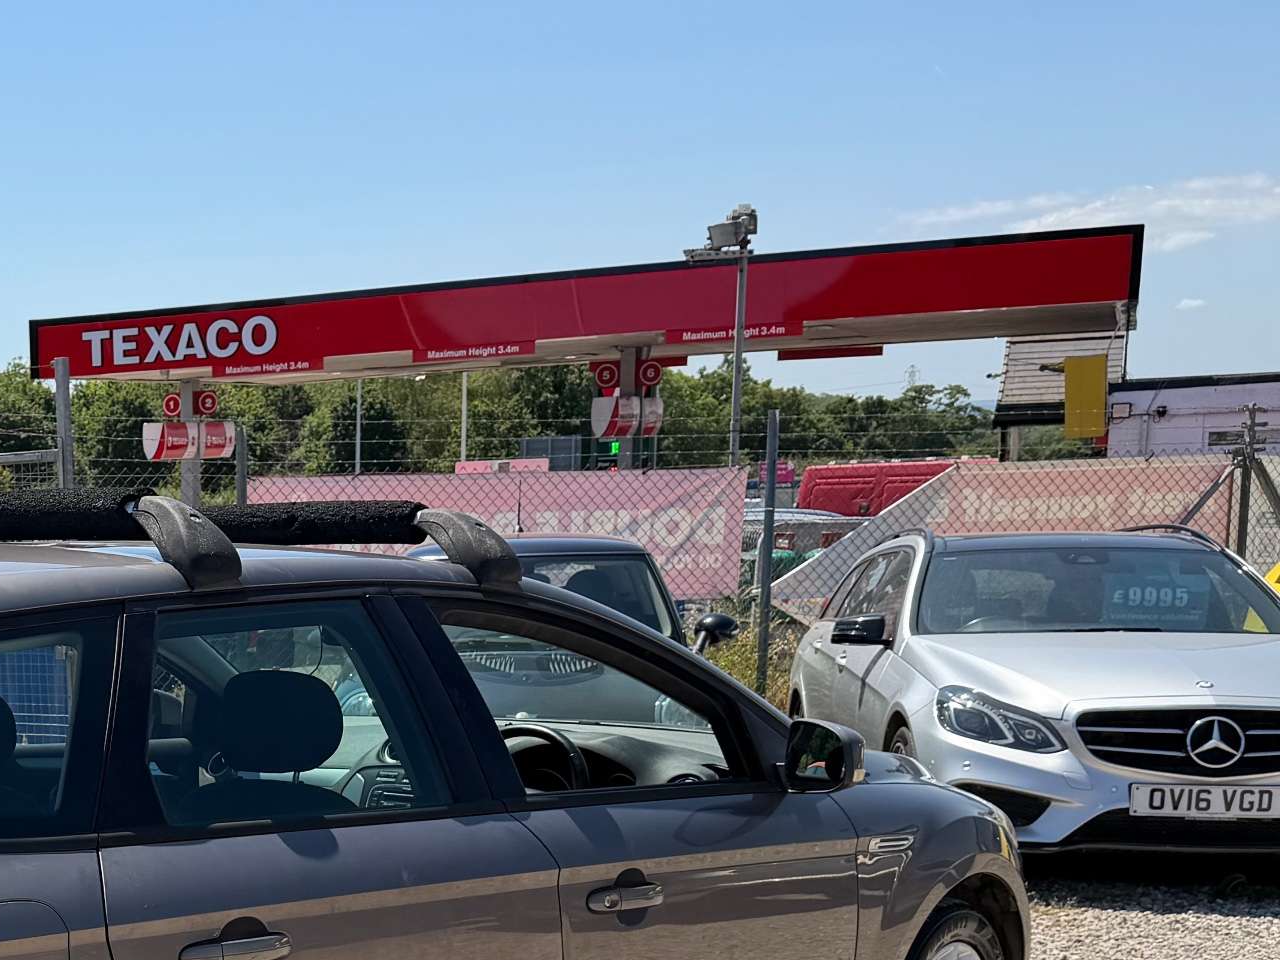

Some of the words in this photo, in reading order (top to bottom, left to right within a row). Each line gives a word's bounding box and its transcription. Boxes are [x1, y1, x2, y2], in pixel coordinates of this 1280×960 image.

[81, 315, 277, 367] TEXACO
[682, 330, 727, 341] Maximum
[728, 327, 759, 338] Hght
[760, 325, 786, 335] 3.4m
[427, 349, 467, 359] Maximum
[468, 346, 496, 357] Height
[498, 344, 520, 354] 3.4m
[225, 364, 261, 375] Maximum
[262, 362, 289, 373] Height
[1111, 585, 1190, 608] £9995
[1148, 787, 1213, 812] OV16
[1222, 788, 1273, 812] VGD
